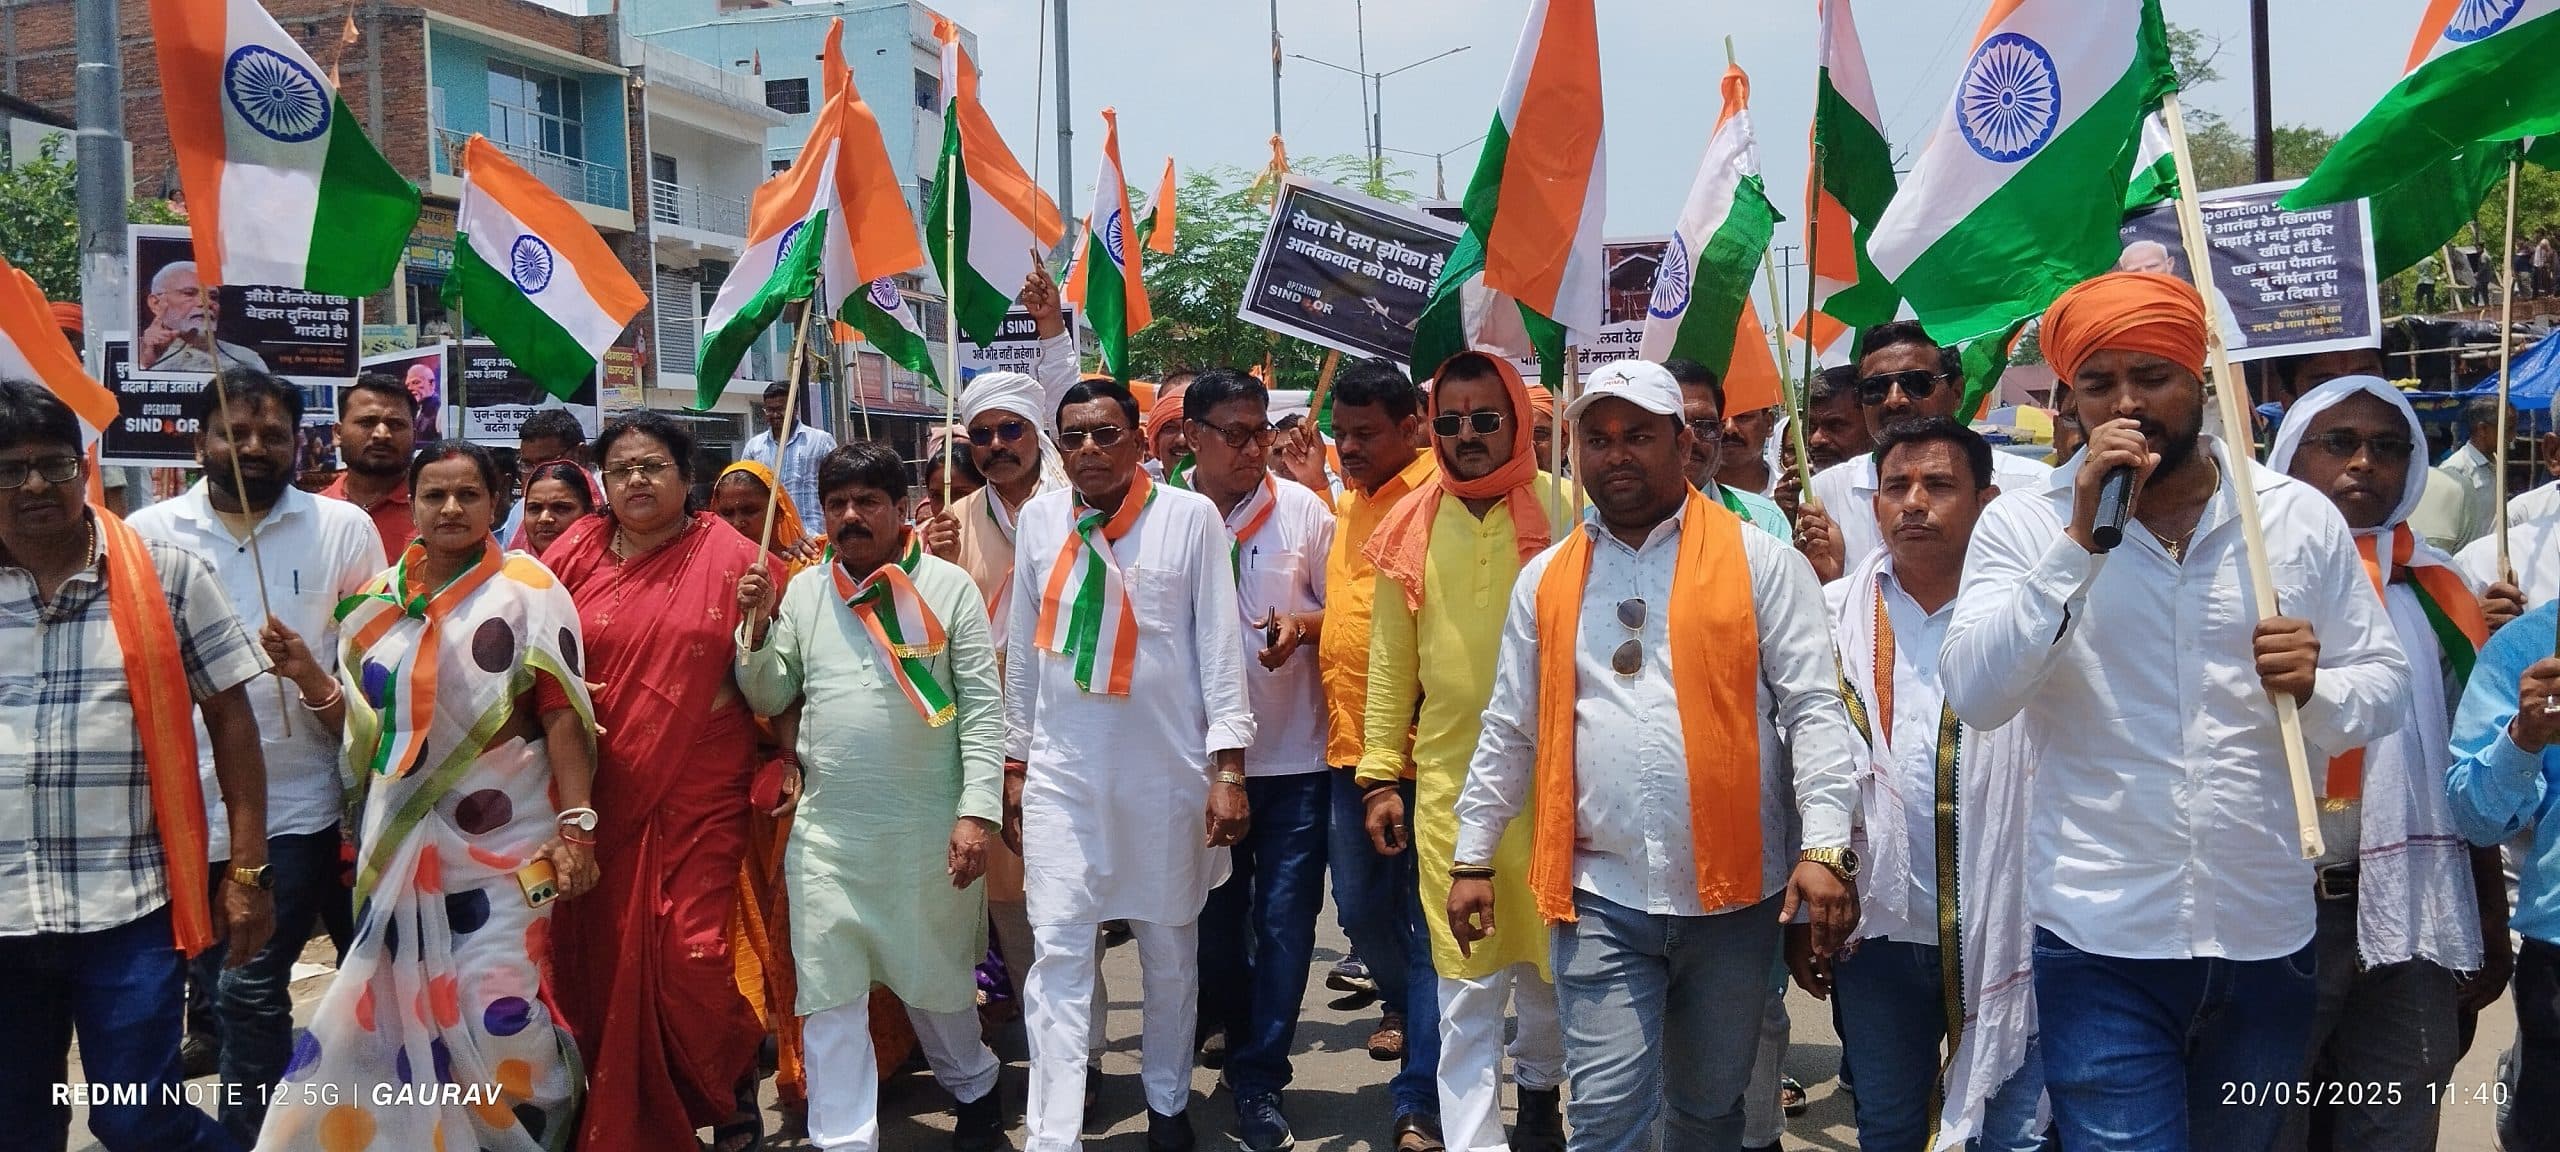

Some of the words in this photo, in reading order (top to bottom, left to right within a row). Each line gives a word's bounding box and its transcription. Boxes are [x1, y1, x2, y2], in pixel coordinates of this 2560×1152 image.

[2214, 219, 2258, 234] आतंक
[2260, 215, 2276, 227] के
[2279, 210, 2333, 225] खिलाफ
[1292, 210, 1329, 236] सेना
[1330, 221, 1347, 243] ने
[1347, 230, 1376, 252] दम
[1376, 240, 1428, 270] झोंका
[2254, 230, 2266, 243] में
[2268, 227, 2290, 241] नई
[2292, 223, 2334, 239] लकीर
[2258, 243, 2290, 257] खींच
[2292, 240, 2309, 254] दी
[1286, 236, 1361, 273] आतंकवाद
[1361, 261, 1386, 280] को
[1386, 268, 1426, 293] ठोका
[2231, 263, 2256, 275] एक
[2259, 260, 2287, 271] नया
[2250, 277, 2272, 291] न्यू
[2271, 271, 2313, 286] नॉर्मल
[2314, 269, 2338, 282] तय
[245, 288, 275, 303] जीरो
[325, 295, 349, 305] एक
[2260, 290, 2285, 302] कर
[2286, 286, 2319, 300] दिया
[245, 304, 285, 320] बेहतर
[286, 307, 328, 324] दुनिया
[329, 308, 350, 321] की
[294, 324, 331, 337] गारंटी
[1007, 320, 1036, 334] SIND
[120, 381, 149, 394] बदला
[150, 381, 168, 394] अब
[484, 423, 510, 433] बदला
